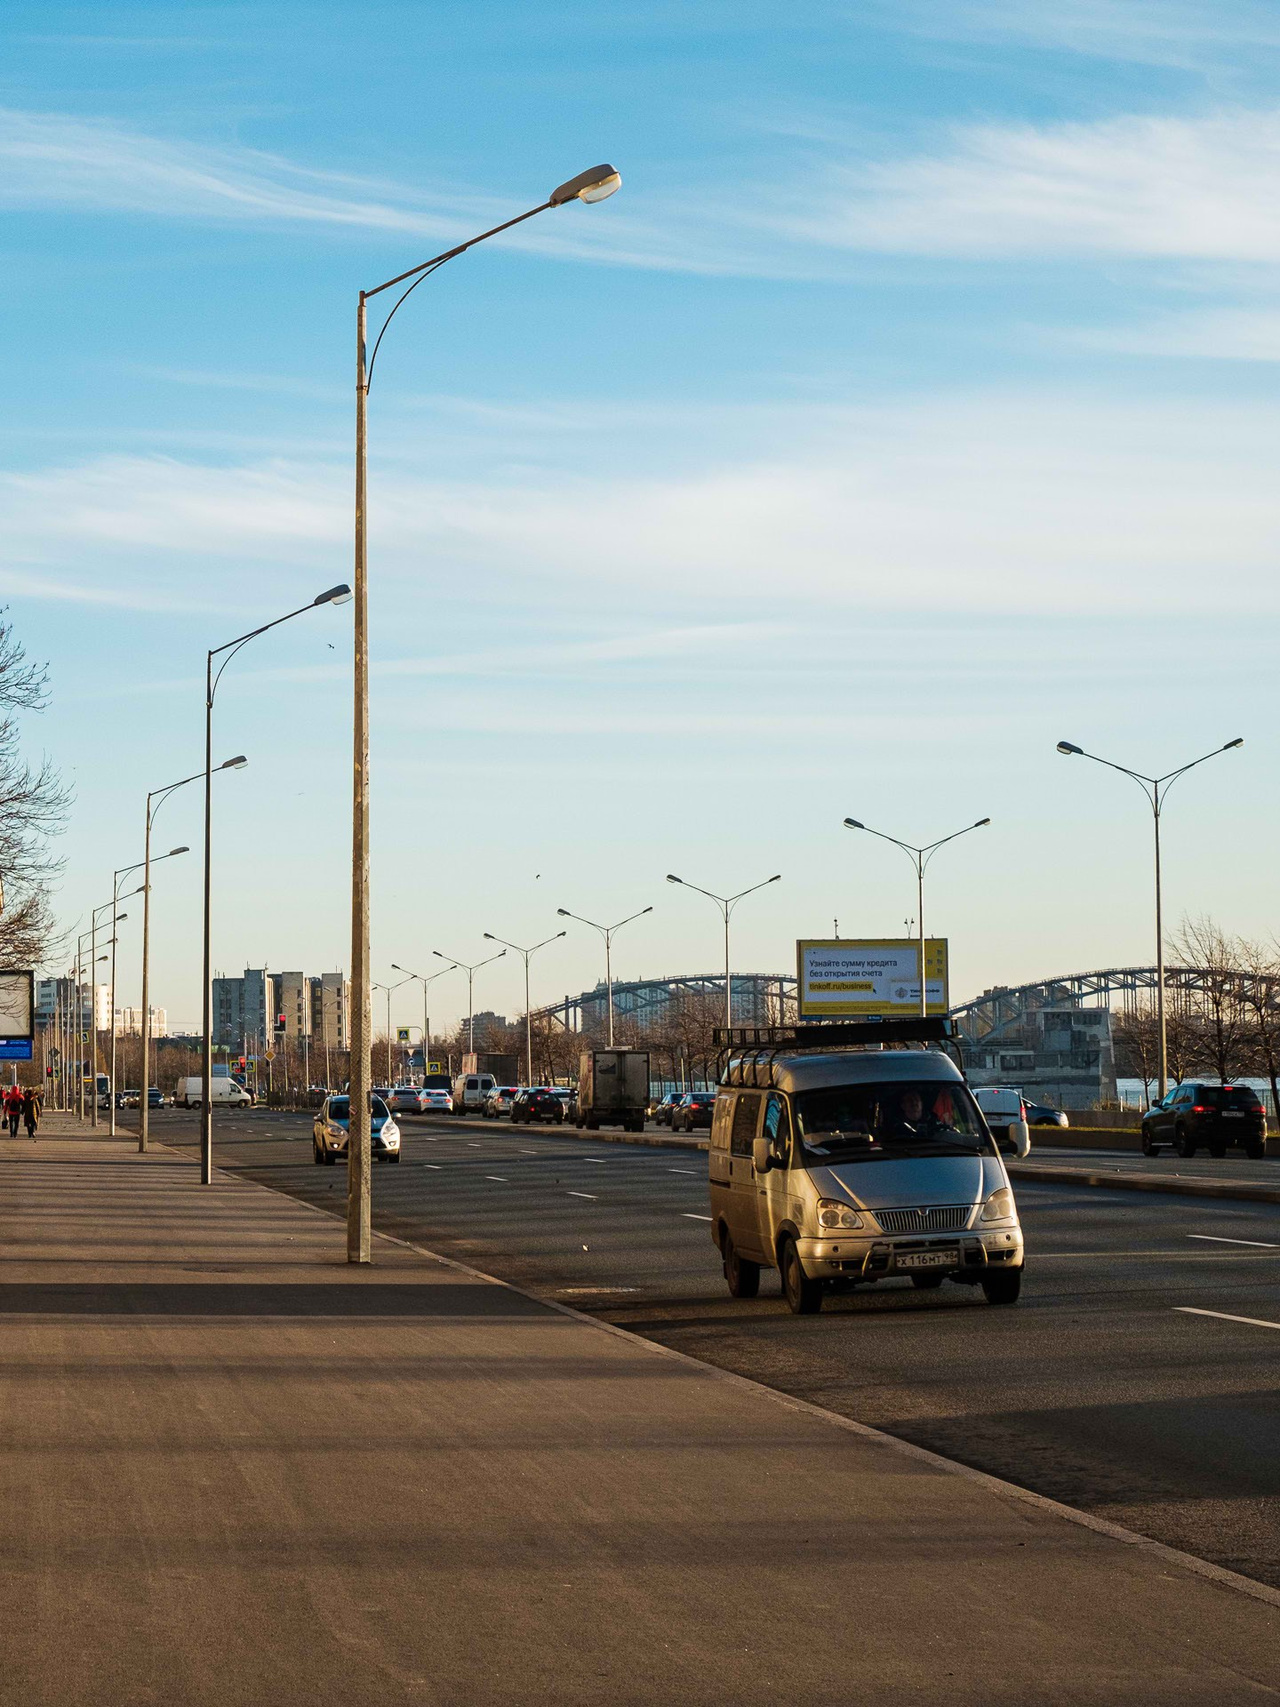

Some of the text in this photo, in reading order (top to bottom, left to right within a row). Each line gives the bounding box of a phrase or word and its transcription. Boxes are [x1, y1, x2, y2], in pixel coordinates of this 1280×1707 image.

[841, 960, 865, 968] сумму
[809, 969, 823, 977] без
[824, 970, 860, 978] открытия
[809, 982, 872, 991] tinkoff.ru/business
